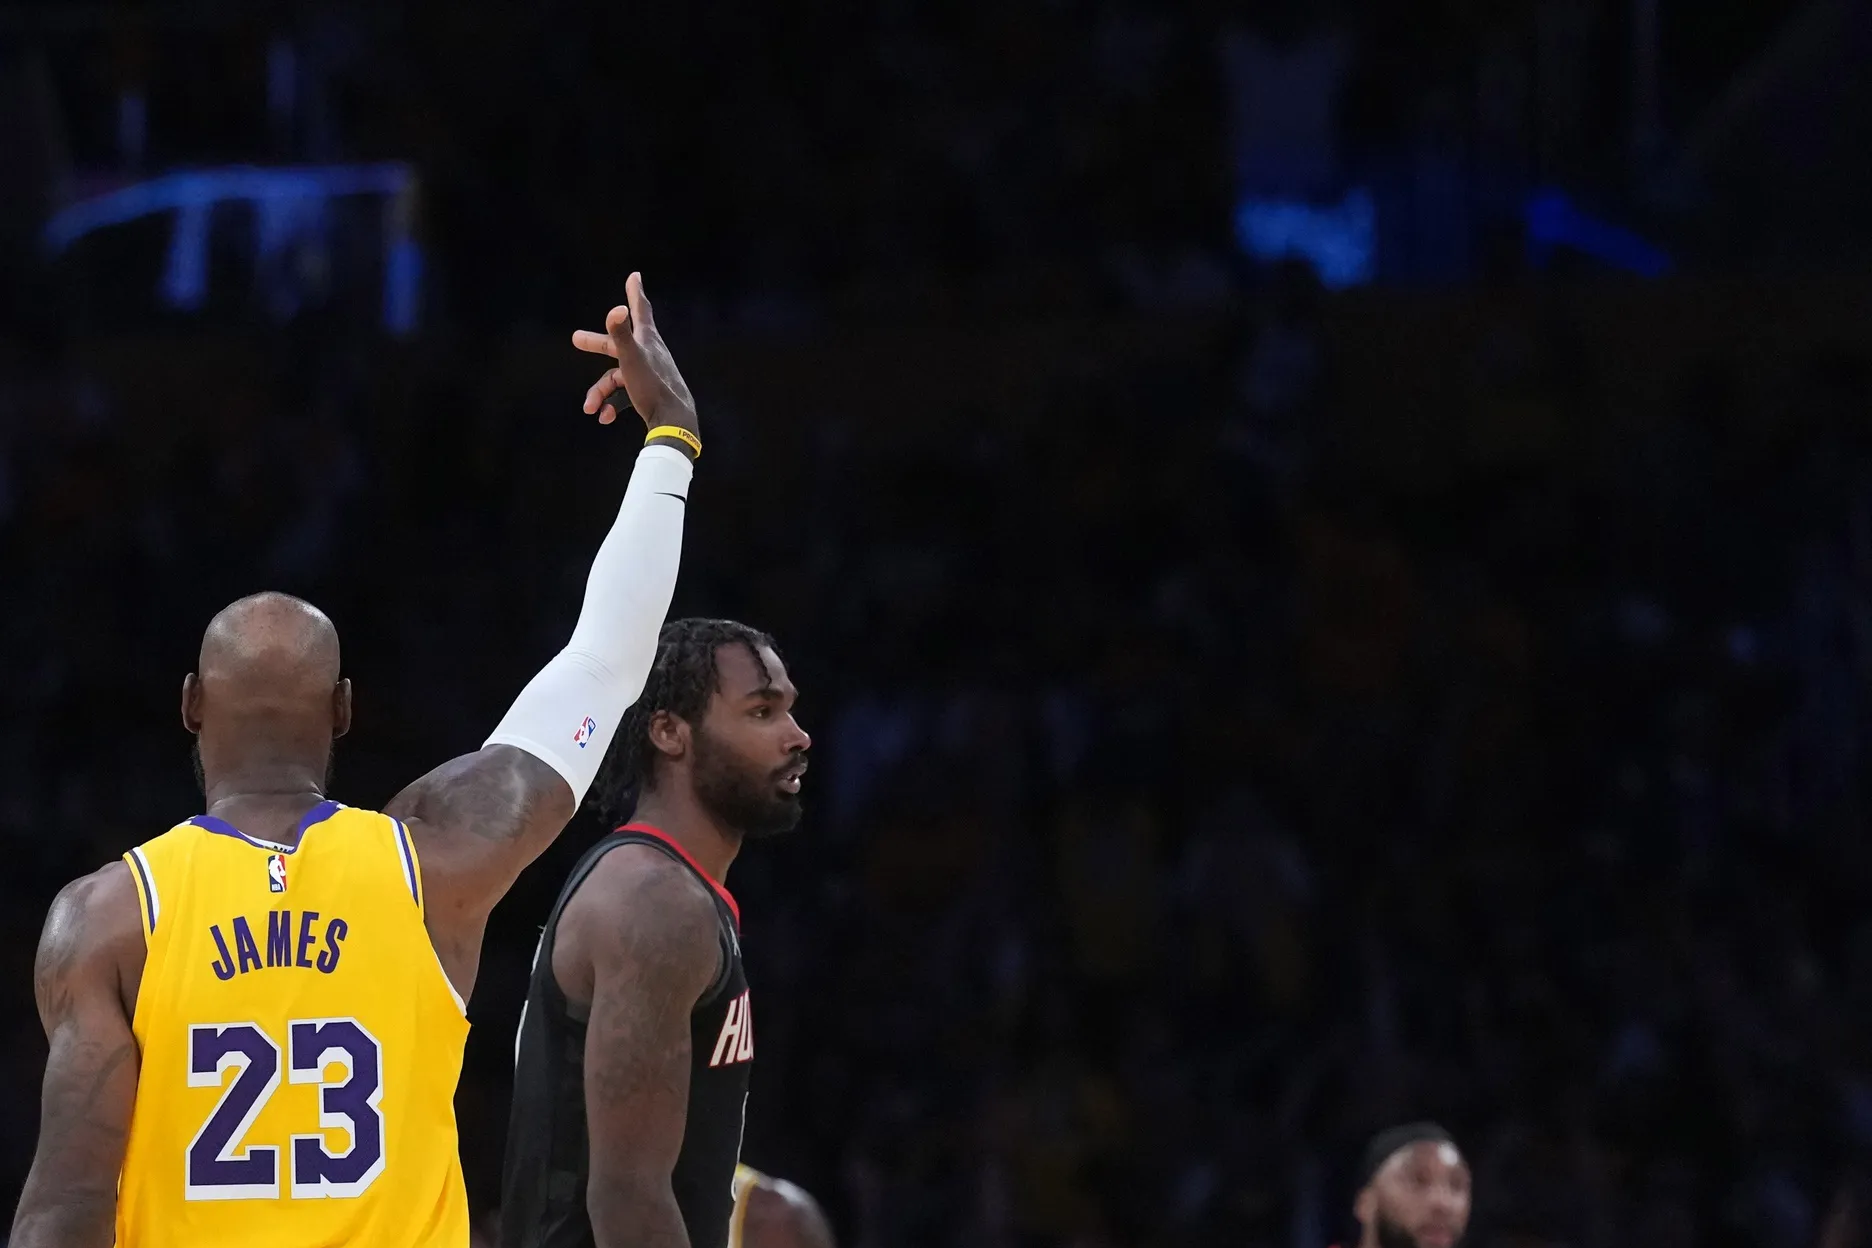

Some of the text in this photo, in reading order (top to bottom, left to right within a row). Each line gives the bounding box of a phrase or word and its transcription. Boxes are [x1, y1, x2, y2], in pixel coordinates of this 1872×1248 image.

[210, 910, 349, 981] JAMES
[709, 988, 754, 1067] HO
[184, 1017, 386, 1201] 23
